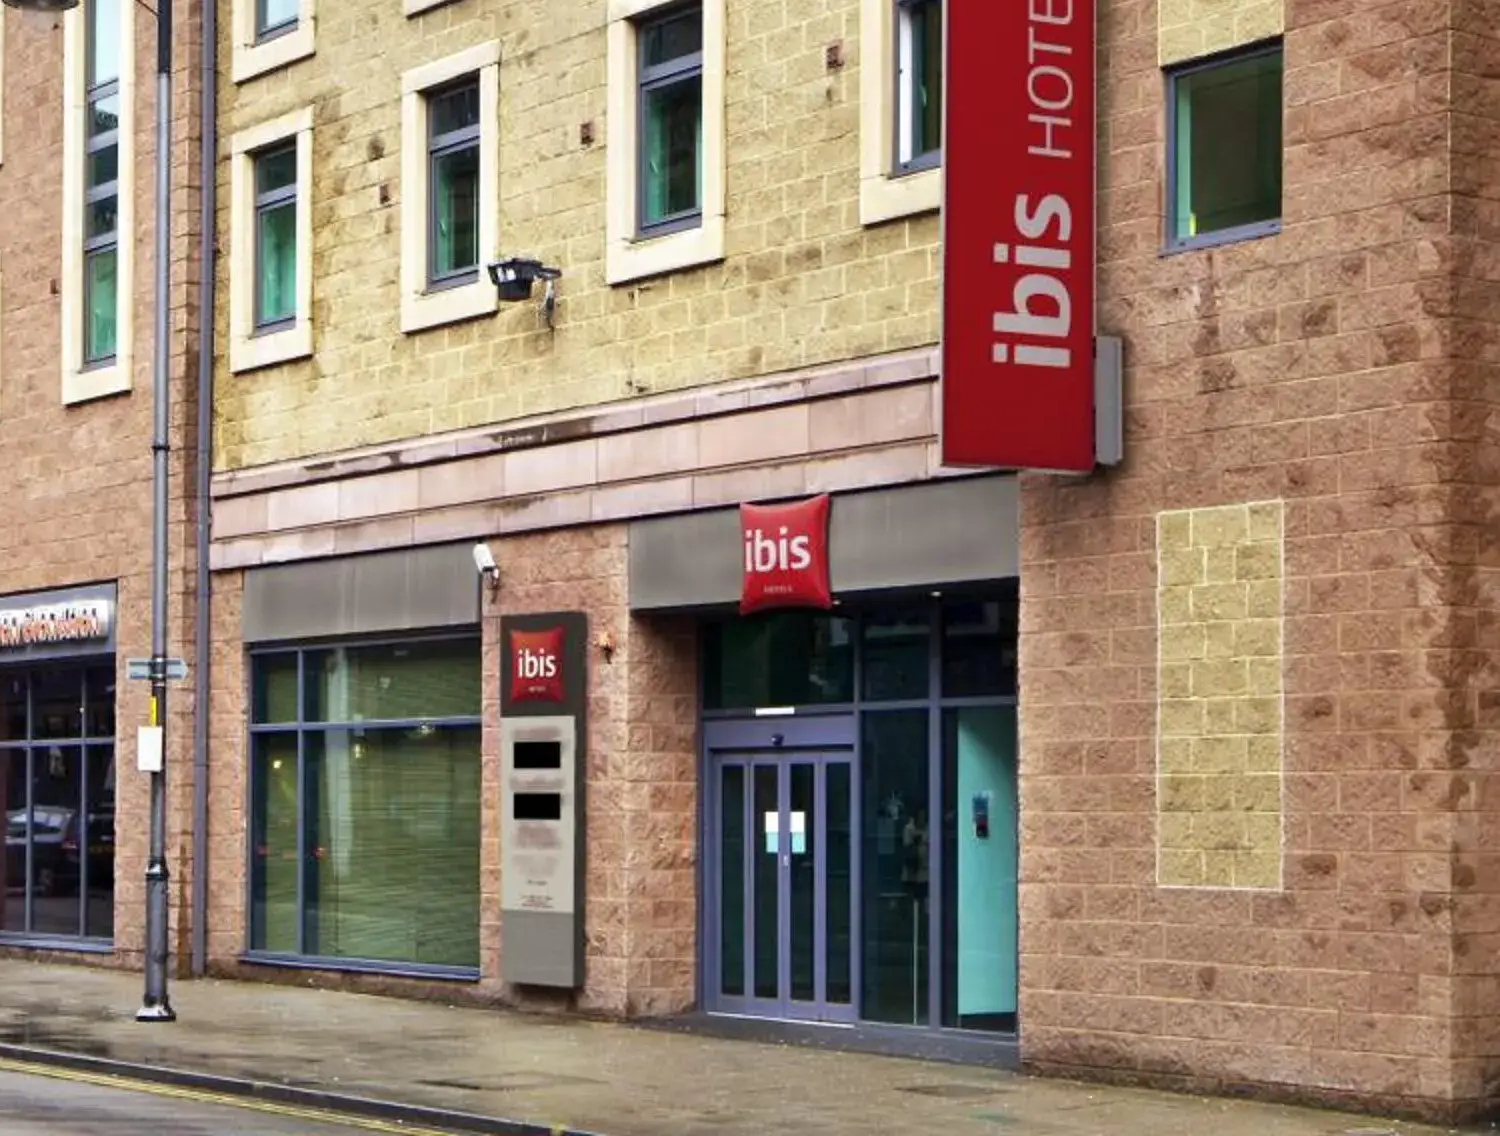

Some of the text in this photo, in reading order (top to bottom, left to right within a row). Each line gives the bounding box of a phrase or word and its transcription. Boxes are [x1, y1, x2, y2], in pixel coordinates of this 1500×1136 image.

[992, 193, 1072, 368] ibis
[745, 526, 811, 573] ibis
[518, 647, 557, 679] ibis
